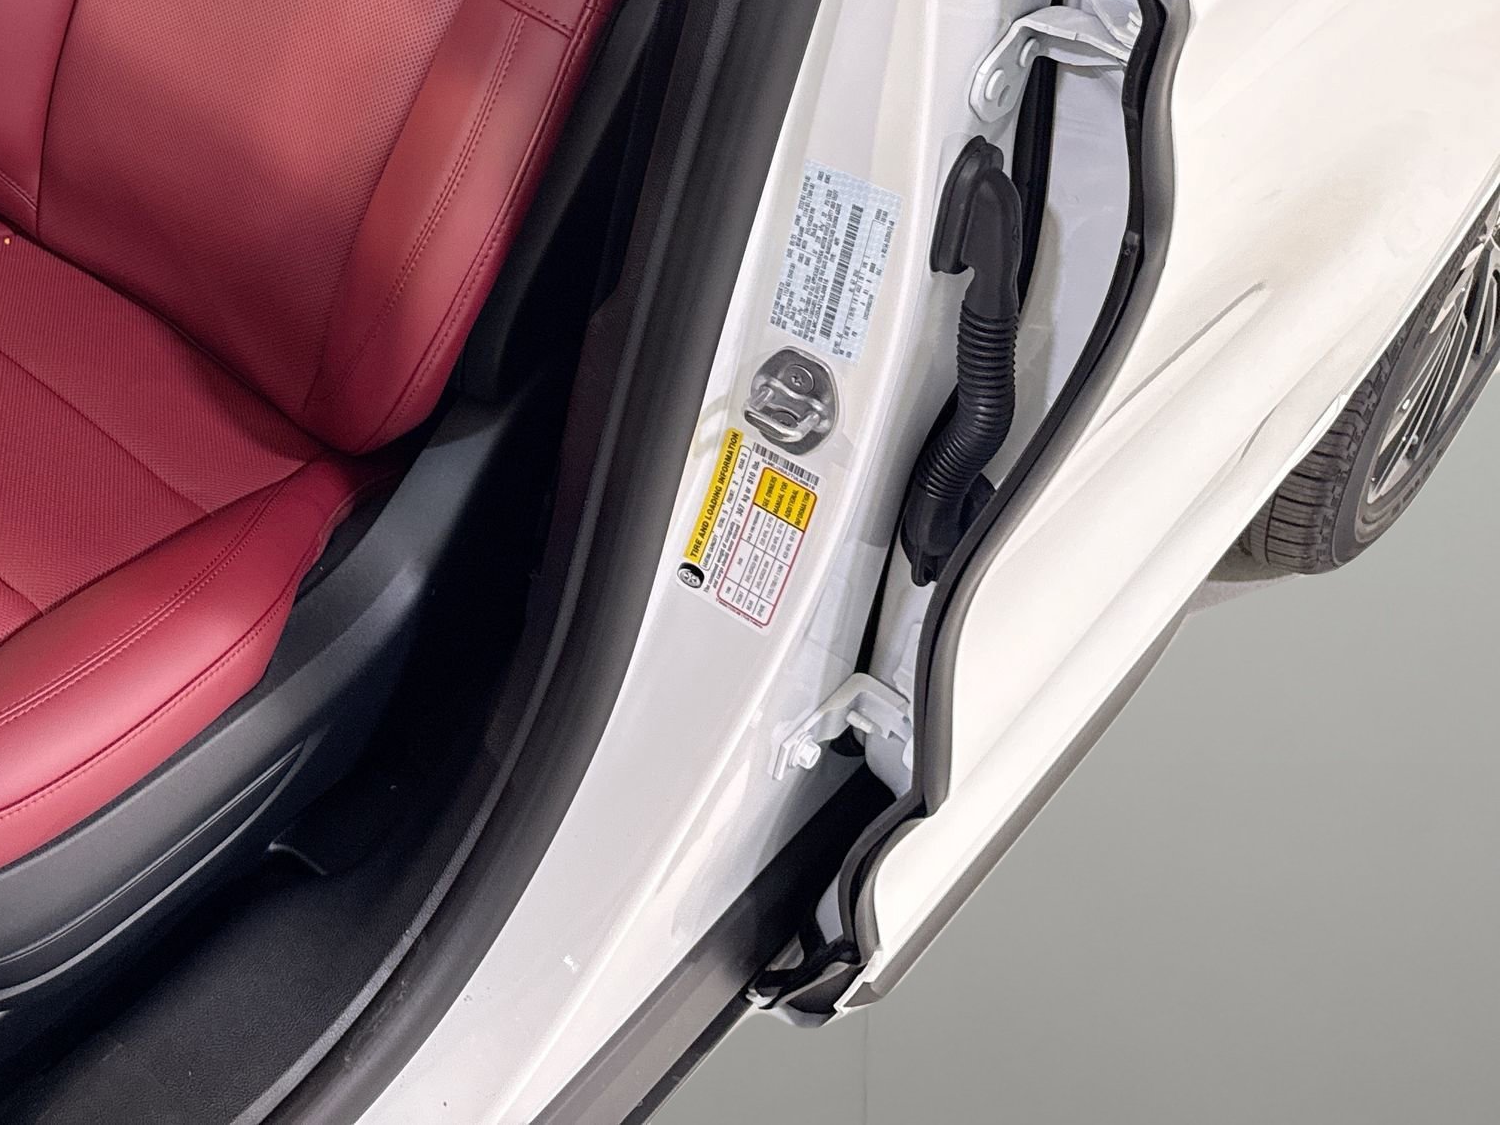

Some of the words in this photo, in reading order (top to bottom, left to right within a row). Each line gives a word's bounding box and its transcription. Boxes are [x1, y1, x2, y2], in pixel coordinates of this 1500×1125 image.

[746, 471, 756, 484] 810
[690, 538, 702, 558] TIRE
[697, 519, 709, 538] AND
[704, 484, 722, 520] LOADING
[717, 431, 739, 484] INFORMATION
[744, 486, 751, 494] or
[741, 493, 750, 503] kg
[761, 496, 770, 508] SEE
[771, 492, 784, 514] MANUAL
[779, 481, 788, 493] FOR
[782, 487, 800, 519] ADDITIONAL
[735, 503, 745, 517] 367
[793, 491, 812, 526] INFORMATION
